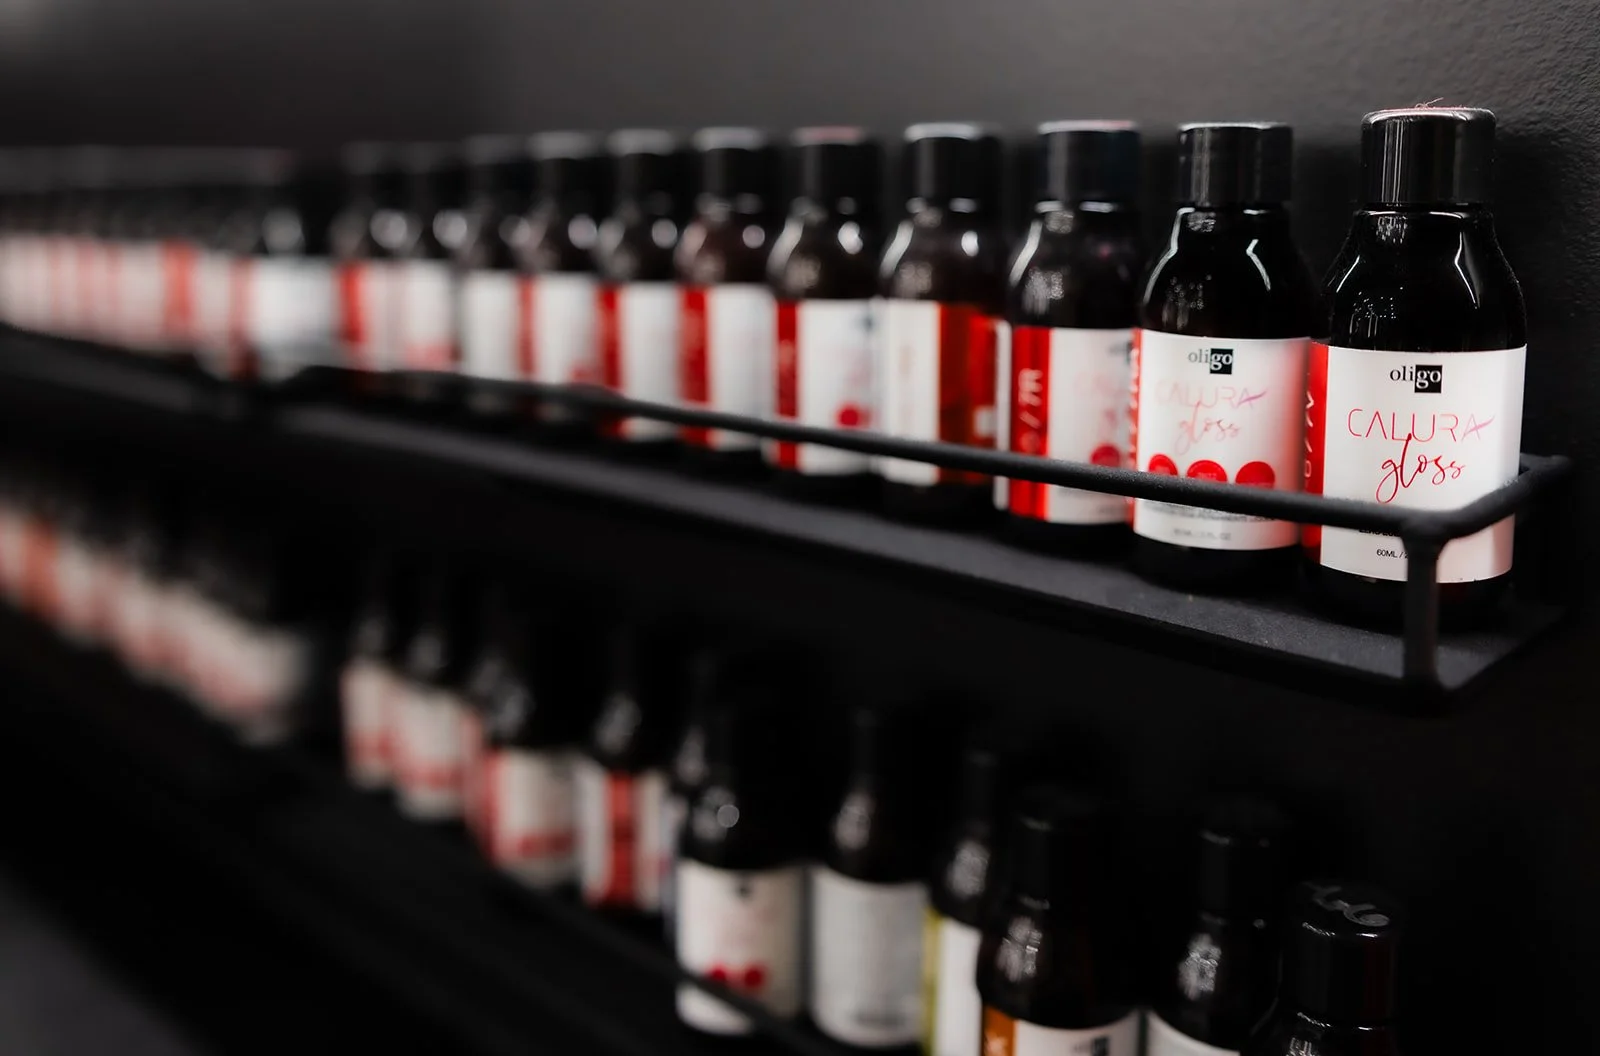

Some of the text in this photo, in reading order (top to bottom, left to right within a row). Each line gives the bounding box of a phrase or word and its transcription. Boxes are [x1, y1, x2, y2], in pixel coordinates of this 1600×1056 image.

[1188, 348, 1233, 374] oligo
[1390, 365, 1442, 393] oligo
[1156, 380, 1267, 408] CALURA
[1174, 400, 1240, 455] gloss
[1348, 408, 1495, 442] CALURA
[1376, 433, 1466, 503] gloss
[1376, 548, 1398, 558] 60ML
